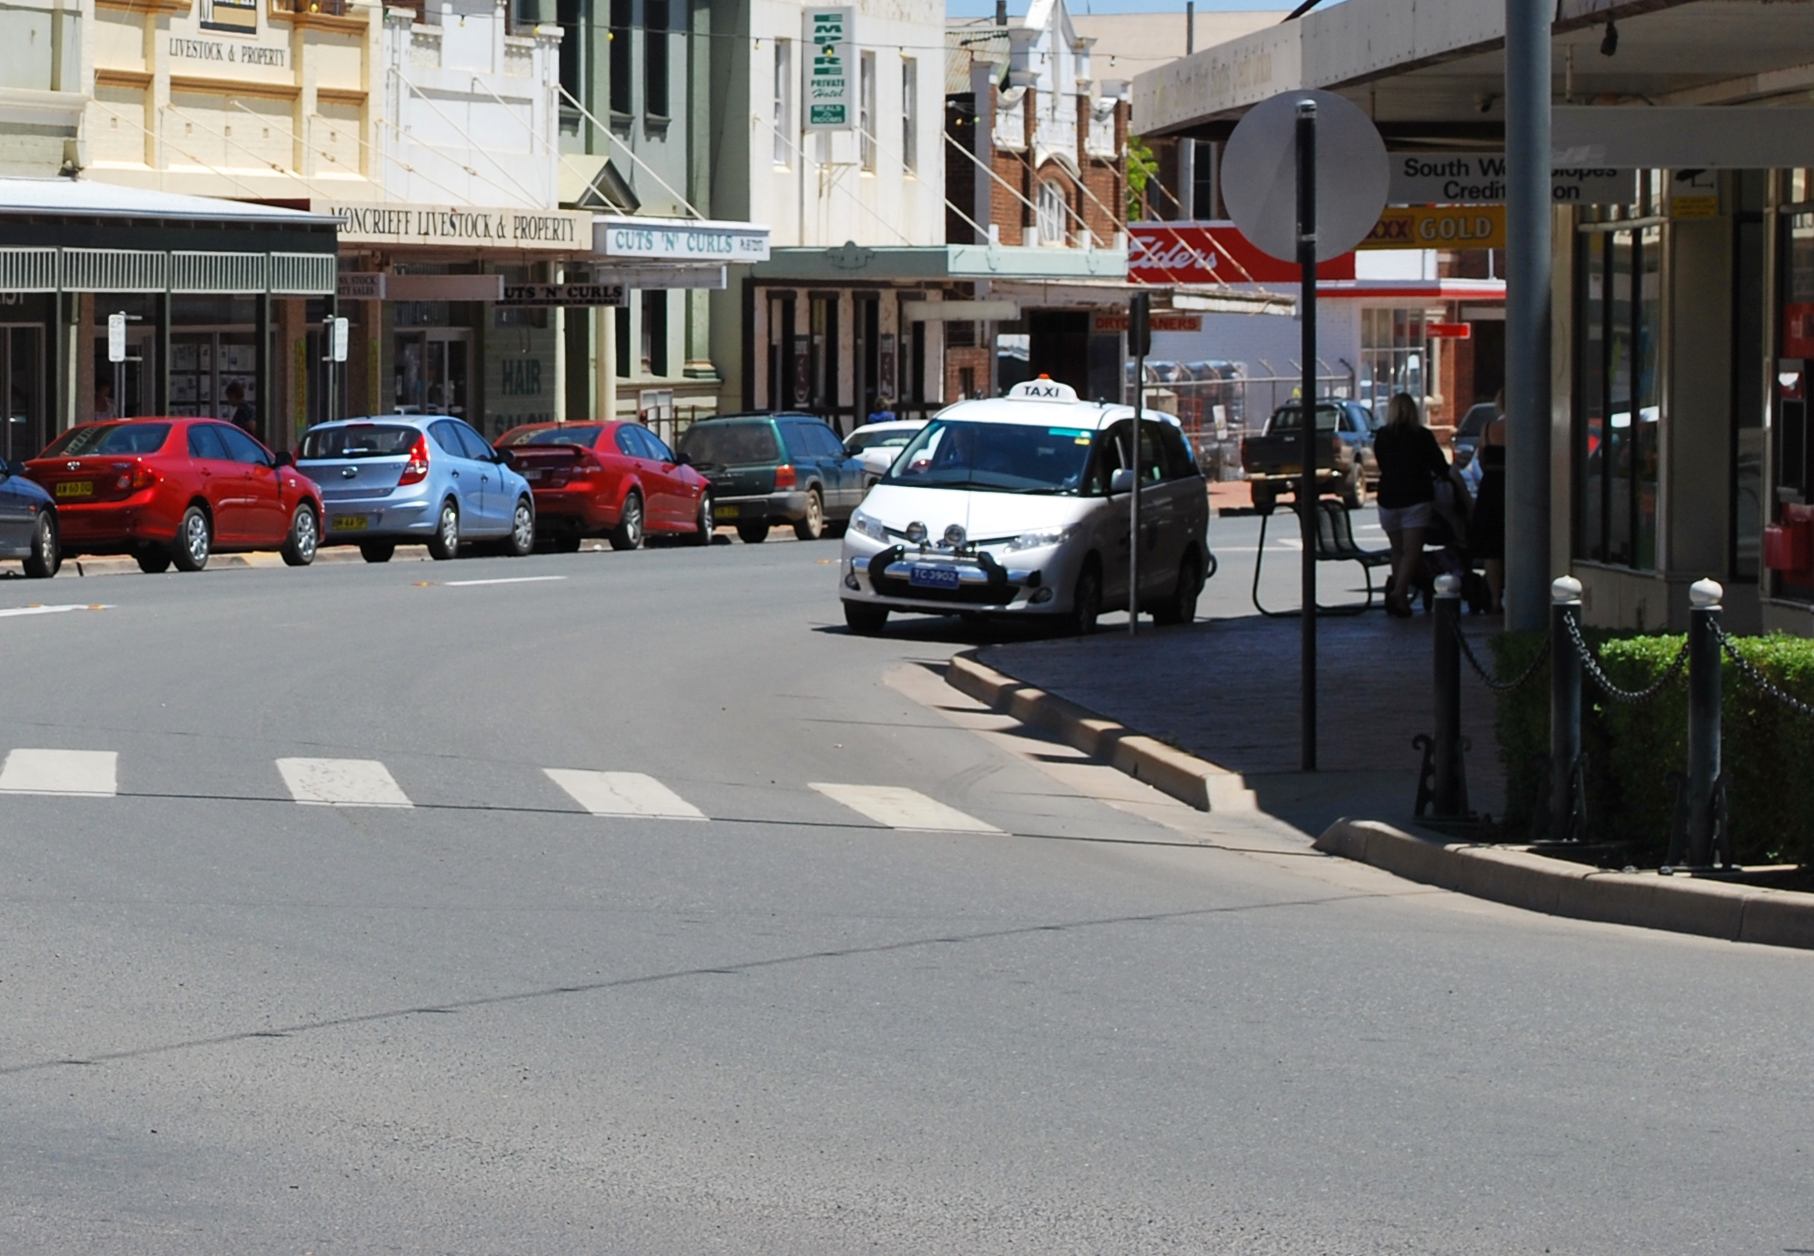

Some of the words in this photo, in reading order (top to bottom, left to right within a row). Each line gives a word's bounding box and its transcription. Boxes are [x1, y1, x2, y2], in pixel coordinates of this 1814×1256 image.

[169, 38, 223, 61] LIVESTOCK
[228, 44, 236, 62] &
[241, 45, 285, 67] PROPERTY
[813, 13, 844, 76] EMPIRE
[811, 78, 845, 88] PRIVATE
[1404, 157, 1470, 178] South
[1443, 180, 1505, 200] Credit
[417, 211, 492, 239] LIVESTOCK
[497, 220, 506, 240] &
[513, 215, 576, 242] PROPERTY
[1418, 217, 1493, 240] GOLD
[615, 230, 654, 251] CUTS
[687, 233, 733, 255] CURLS
[1127, 235, 1218, 270] Elders
[504, 287, 535, 299] UTS
[566, 285, 623, 299] CURLS
[1094, 315, 1197, 331] DRYCANERS
[502, 358, 541, 395] HAIR
[1023, 384, 1060, 398] TAXI
